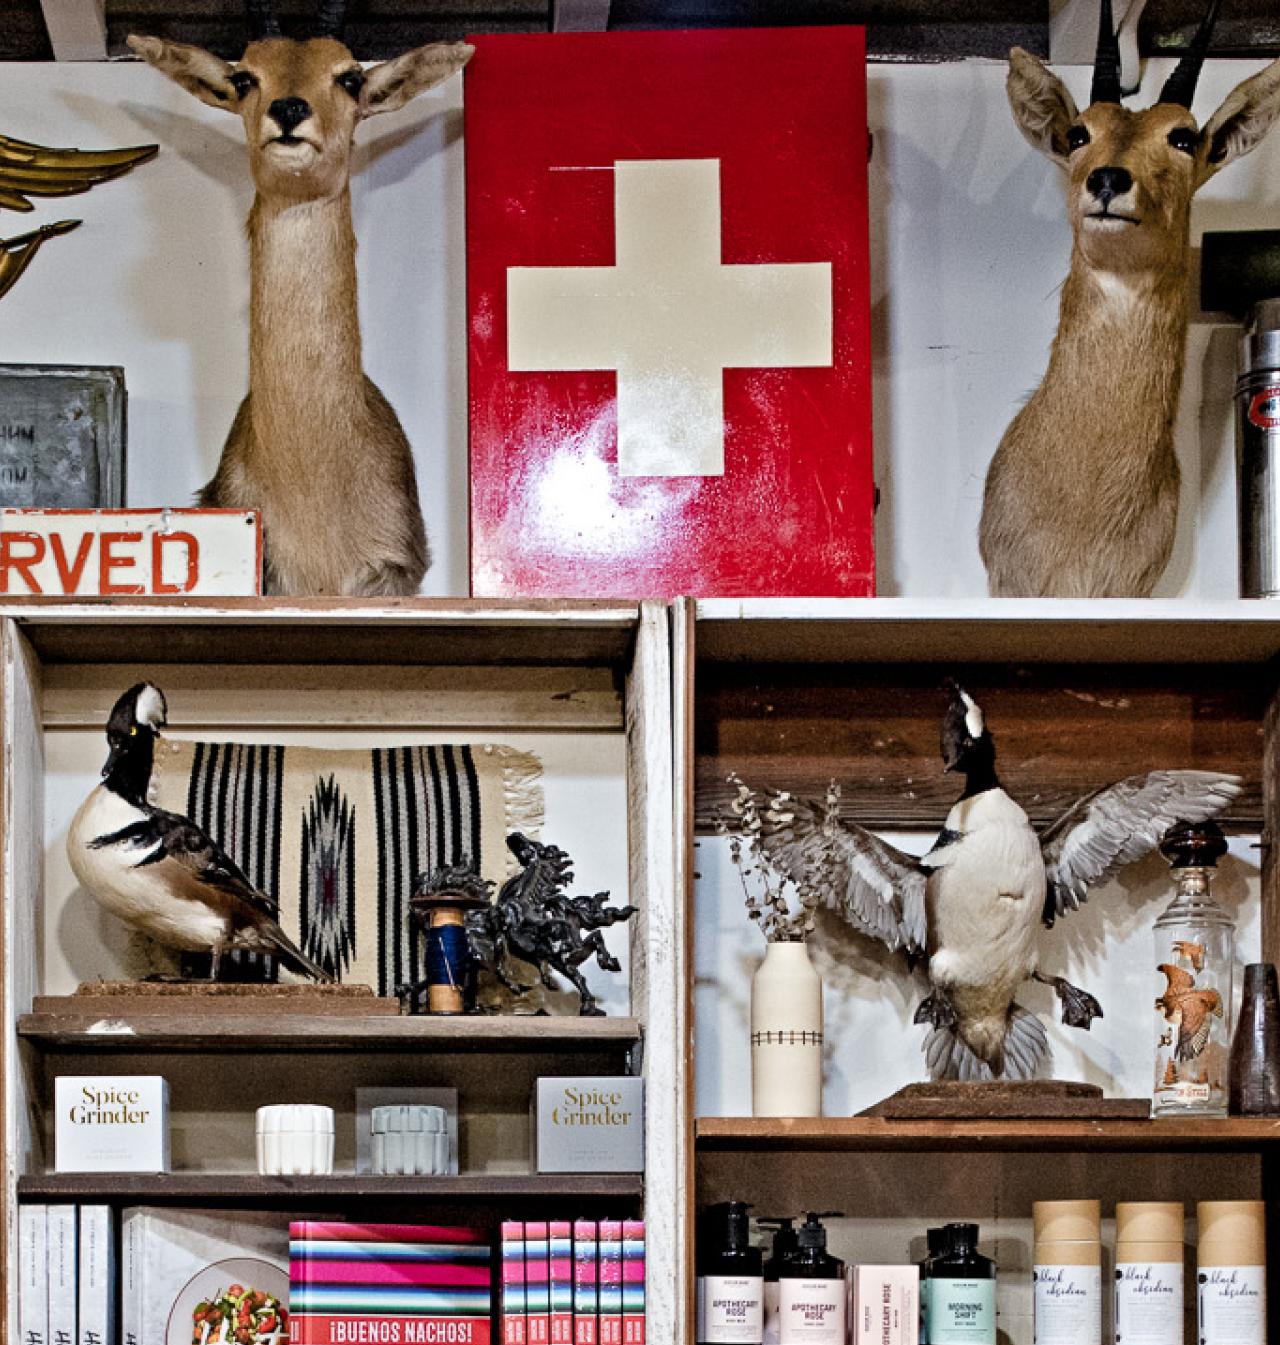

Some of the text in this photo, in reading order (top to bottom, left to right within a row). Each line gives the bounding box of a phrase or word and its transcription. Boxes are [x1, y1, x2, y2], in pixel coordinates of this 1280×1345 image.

[82, 1086, 140, 1109] Spice
[564, 1086, 622, 1109] Spice
[69, 1105, 150, 1126] Grinder
[552, 1105, 632, 1126] Grinder
[1038, 1269, 1064, 1283] black
[1124, 1266, 1153, 1281] black
[1209, 1270, 1238, 1284] black
[882, 1283, 891, 1304] ROSE
[1046, 1282, 1087, 1297] obsidian
[1133, 1279, 1174, 1295] obsidian
[1219, 1282, 1259, 1298] obsidian
[726, 1307, 746, 1317] ROSE
[791, 1303, 838, 1312] APOTHECARY
[947, 1302, 983, 1311] MORNING
[804, 1311, 825, 1321] ROSE
[329, 1319, 473, 1345] ¡BUENOS NACHOS!
